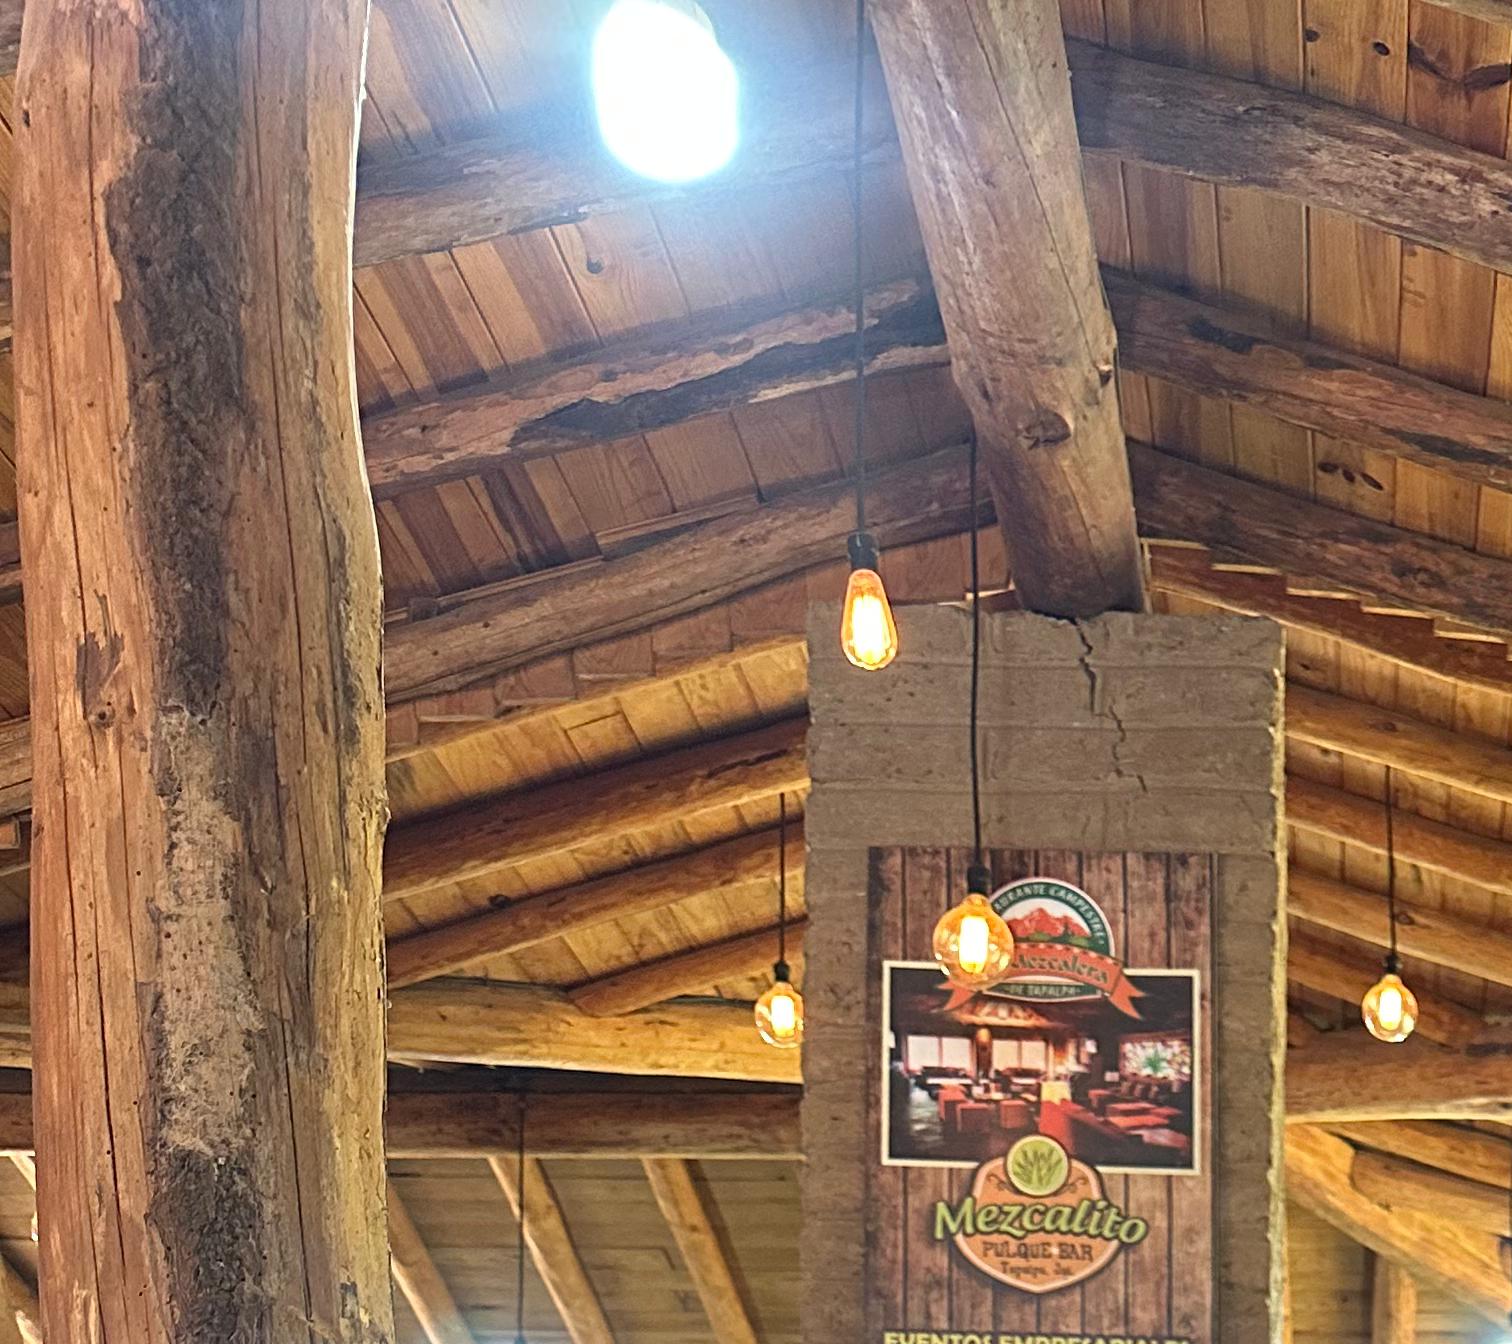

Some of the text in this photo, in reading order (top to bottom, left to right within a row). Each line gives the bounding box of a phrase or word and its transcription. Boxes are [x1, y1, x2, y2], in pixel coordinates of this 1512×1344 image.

[933, 1195, 1149, 1246] Mezcalito
[982, 1241, 1093, 1262] PULQUE BAR
